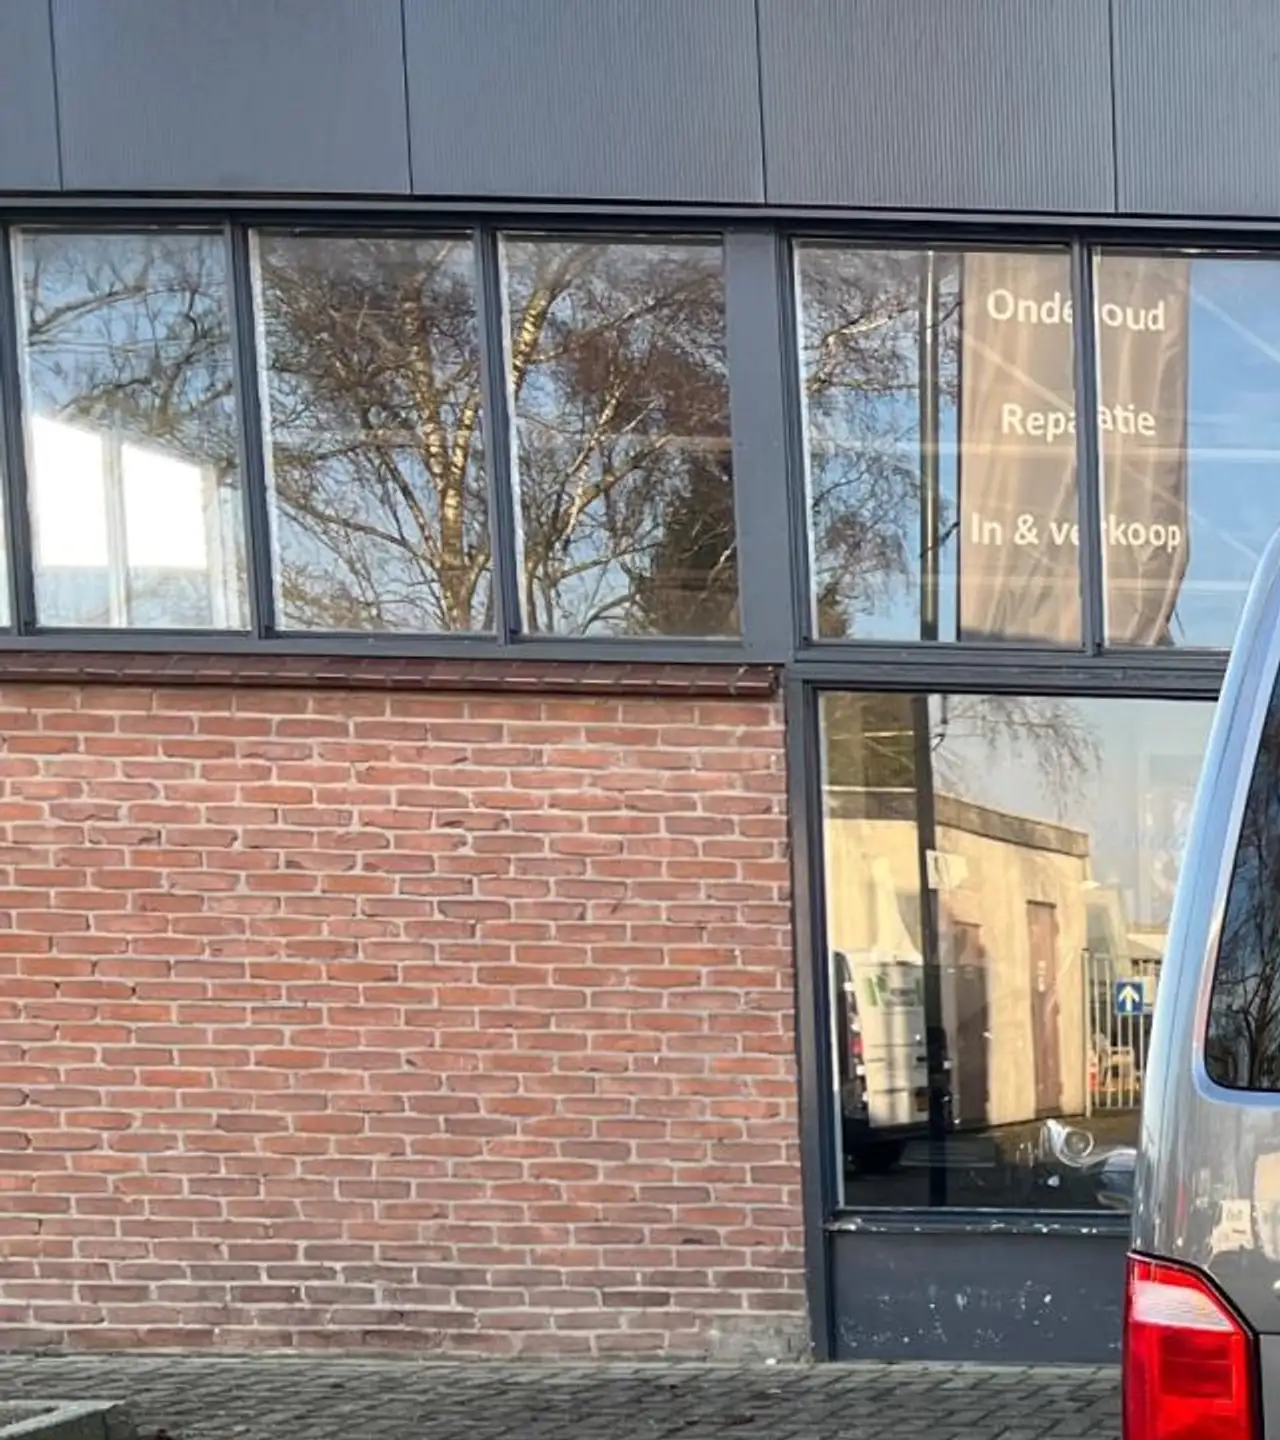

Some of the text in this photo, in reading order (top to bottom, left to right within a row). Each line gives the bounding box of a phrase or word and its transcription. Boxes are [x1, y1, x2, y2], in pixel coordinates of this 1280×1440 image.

[986, 288, 1166, 331] Ondeoud
[1002, 402, 1157, 442] Repaatie
[971, 512, 1181, 554] In & vekoop
